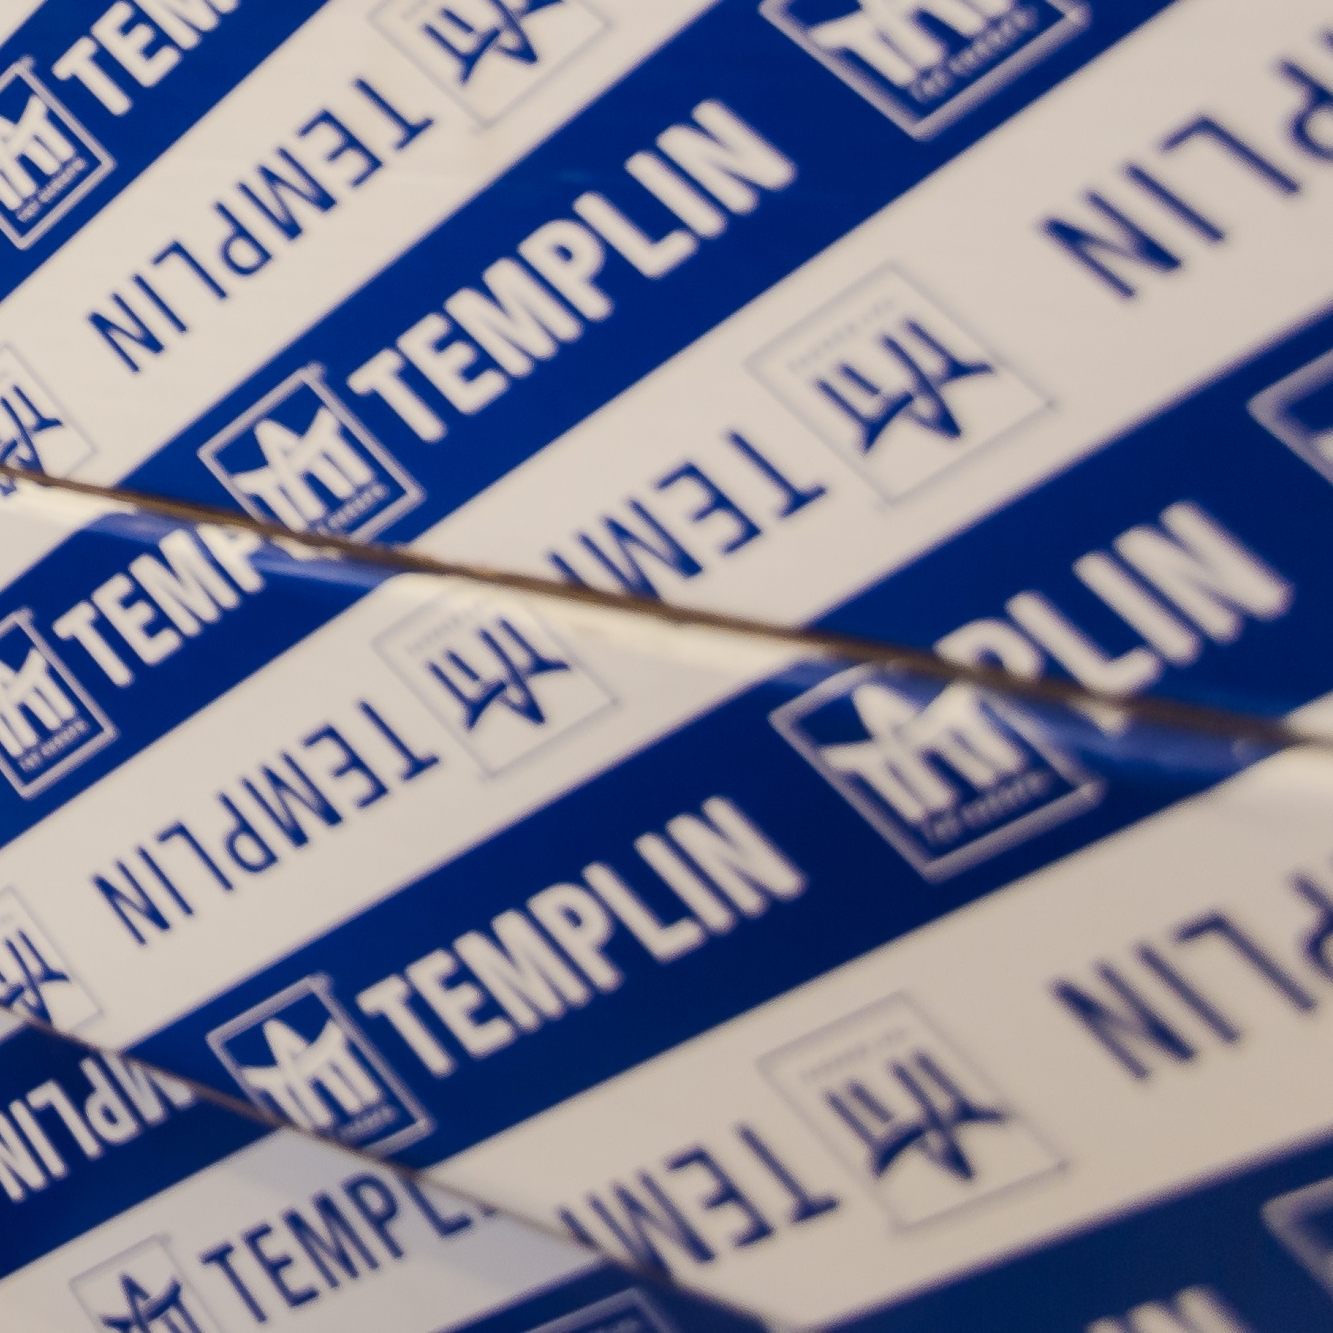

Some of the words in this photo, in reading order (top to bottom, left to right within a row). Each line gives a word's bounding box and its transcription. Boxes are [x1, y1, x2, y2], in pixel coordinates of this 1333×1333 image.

[86, 77, 436, 375] TEMPLIN
[347, 98, 798, 444] TEMPLIN
[1038, 55, 1333, 302] PLIN
[52, 521, 268, 688] TEMP
[89, 699, 441, 948] TEMPLIN
[356, 796, 807, 1079] TEMPLIN
[200, 1171, 475, 1325] TEMPL
